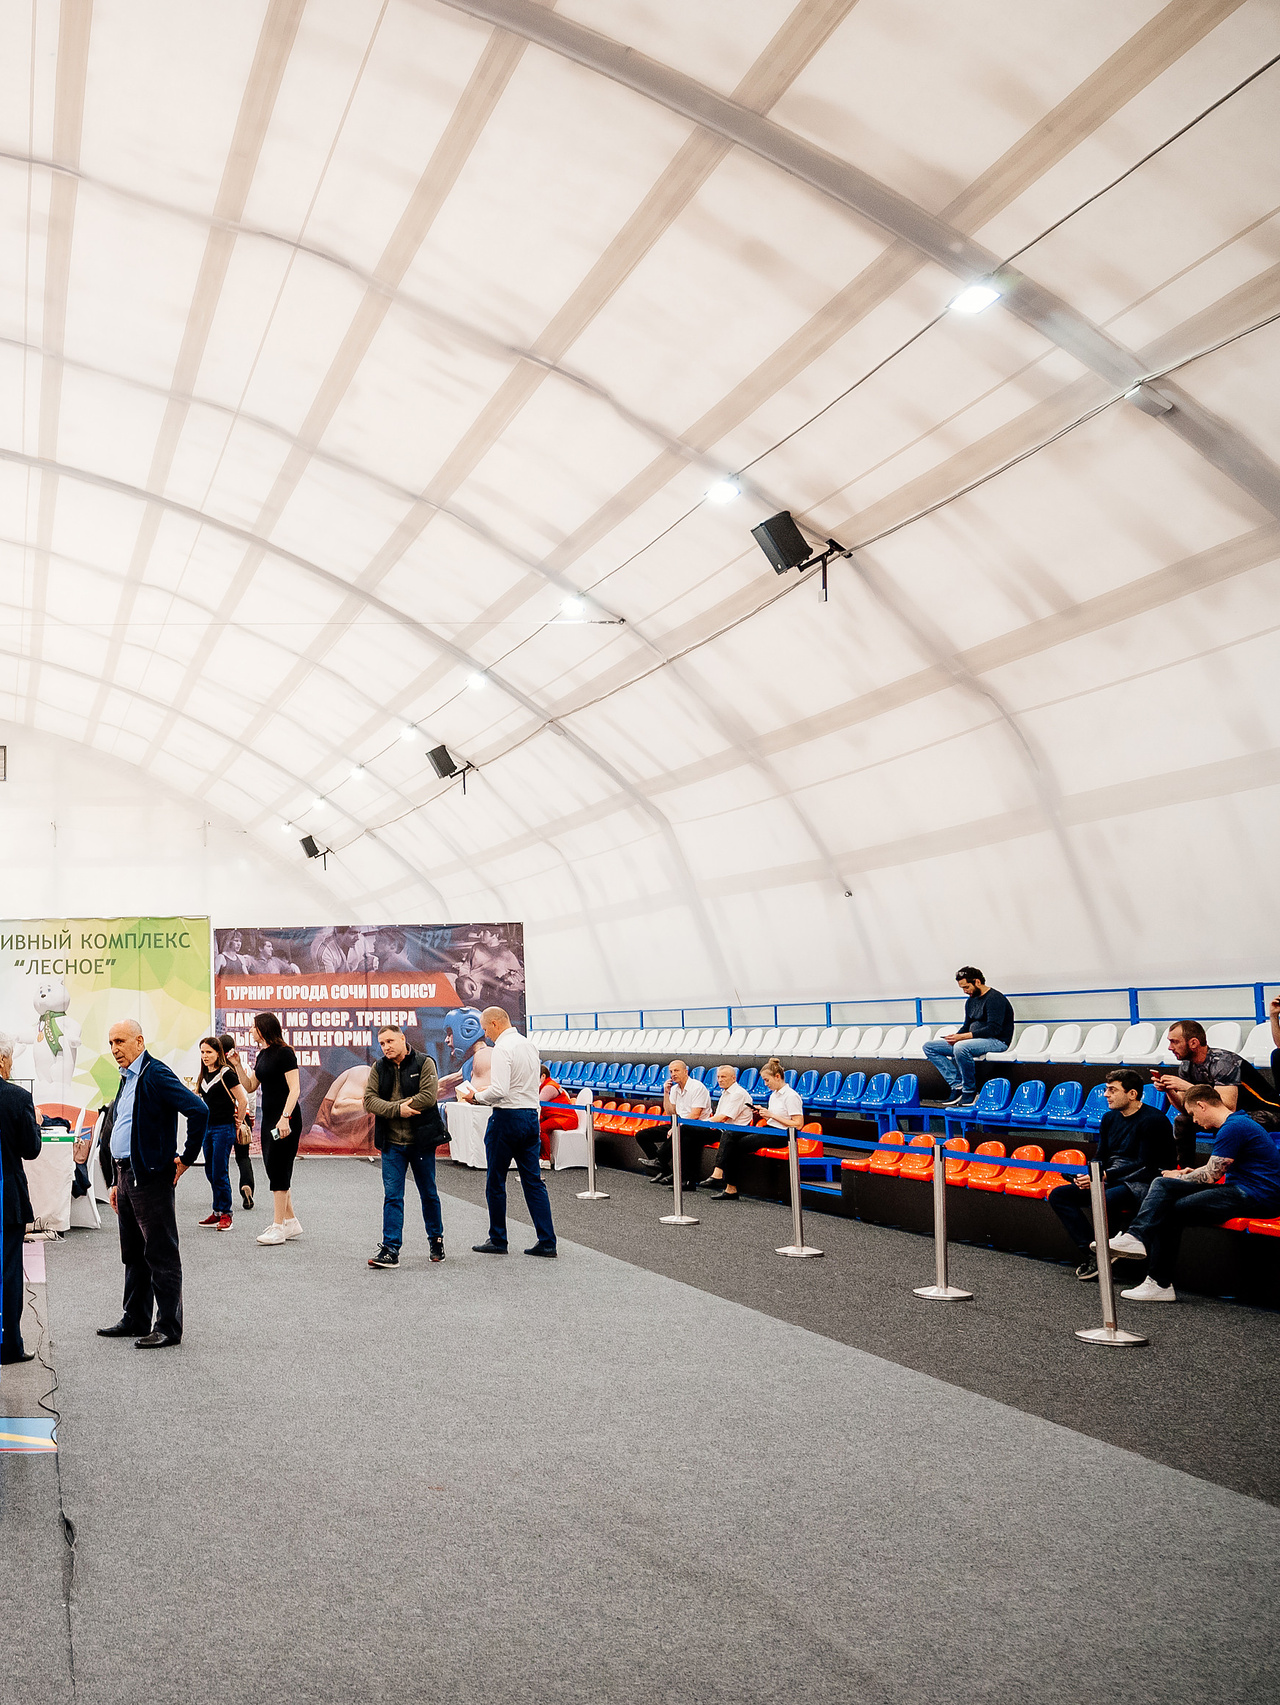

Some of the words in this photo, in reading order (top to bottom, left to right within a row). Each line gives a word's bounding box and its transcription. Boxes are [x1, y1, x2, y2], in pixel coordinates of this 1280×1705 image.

[81, 932, 191, 950] КОМПЛЕКС
[224, 985, 274, 1001] ТУРНИР
[276, 984, 329, 1002] ГОРОДА
[330, 984, 368, 1000] СОЧИ
[369, 984, 389, 999] ПО
[391, 983, 437, 999] БОКСУ
[226, 1011, 283, 1028] ПАМИ
[286, 1011, 309, 1027] МС
[311, 1011, 354, 1028] СССР,
[355, 1010, 418, 1027] ТРЕНЕРА
[292, 1030, 373, 1047] КАТЕГОРИИ
